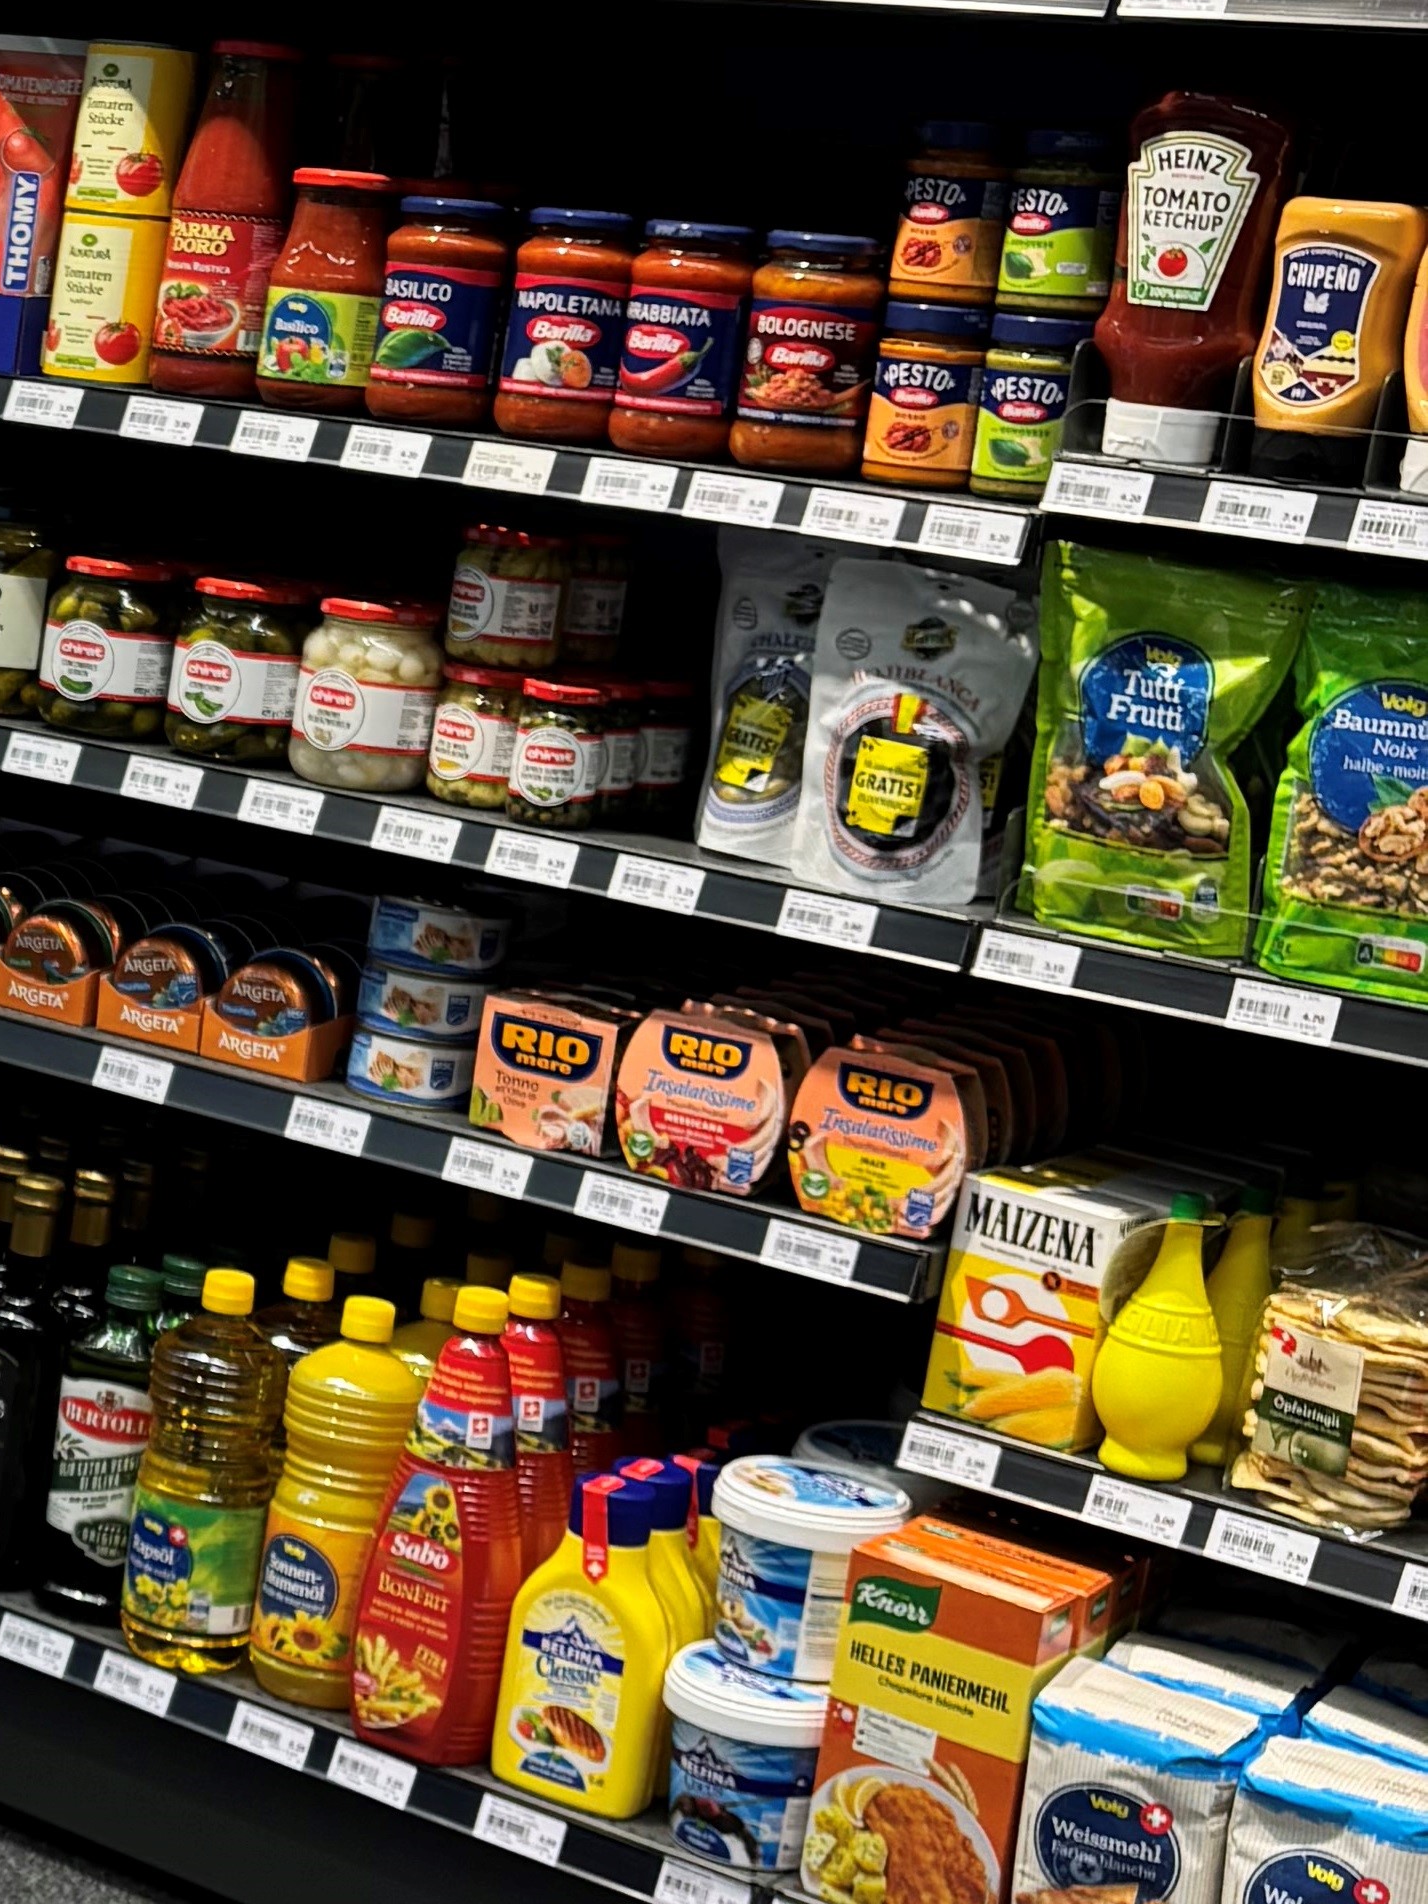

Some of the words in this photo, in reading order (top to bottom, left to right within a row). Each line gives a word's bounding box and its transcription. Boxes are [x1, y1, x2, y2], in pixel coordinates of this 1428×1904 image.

[1158, 148, 1228, 176] HEINZ
[1143, 185, 1232, 213] TOMATO
[4, 171, 40, 290] THOMY
[170, 219, 236, 243] PARMA
[1143, 210, 1224, 233] KETCHUP
[172, 234, 228, 257] DORO
[385, 277, 452, 302] BASILICO
[518, 290, 622, 317] NAPOLETANA
[384, 307, 440, 330] Barilla
[530, 320, 597, 344] Barilla
[757, 314, 856, 341] BOLOGNESE
[626, 330, 683, 355] Barilla
[888, 362, 949, 391] PESTO
[995, 377, 1058, 404] PESTO
[1123, 668, 1184, 704] Tutti
[1106, 701, 1184, 733] Frutti
[1372, 738, 1419, 760] Noix
[854, 770, 921, 802] GRATIS!
[7, 982, 63, 1010] ARGETA
[119, 1005, 178, 1033] ARGETA
[218, 1032, 280, 1062] ARGETA
[500, 1019, 590, 1067] RIO
[668, 1033, 744, 1066] RIO
[515, 1052, 573, 1076] mare
[679, 1055, 729, 1077] mare
[643, 1068, 756, 1114] Insalatissime
[846, 1069, 924, 1108] RIO
[857, 1094, 908, 1115] mare
[820, 1105, 938, 1152] Insalatissime
[964, 1191, 1097, 1270] MAIZENA
[390, 1536, 450, 1570] Sabo
[855, 1579, 932, 1626] Knorr
[849, 1639, 906, 1678] HELLES
[909, 1658, 1011, 1714] PANIERMEHL
[1088, 1794, 1129, 1819] Volg
[1050, 1815, 1163, 1864] Weissmehl
[1306, 1862, 1346, 1891] Volg
